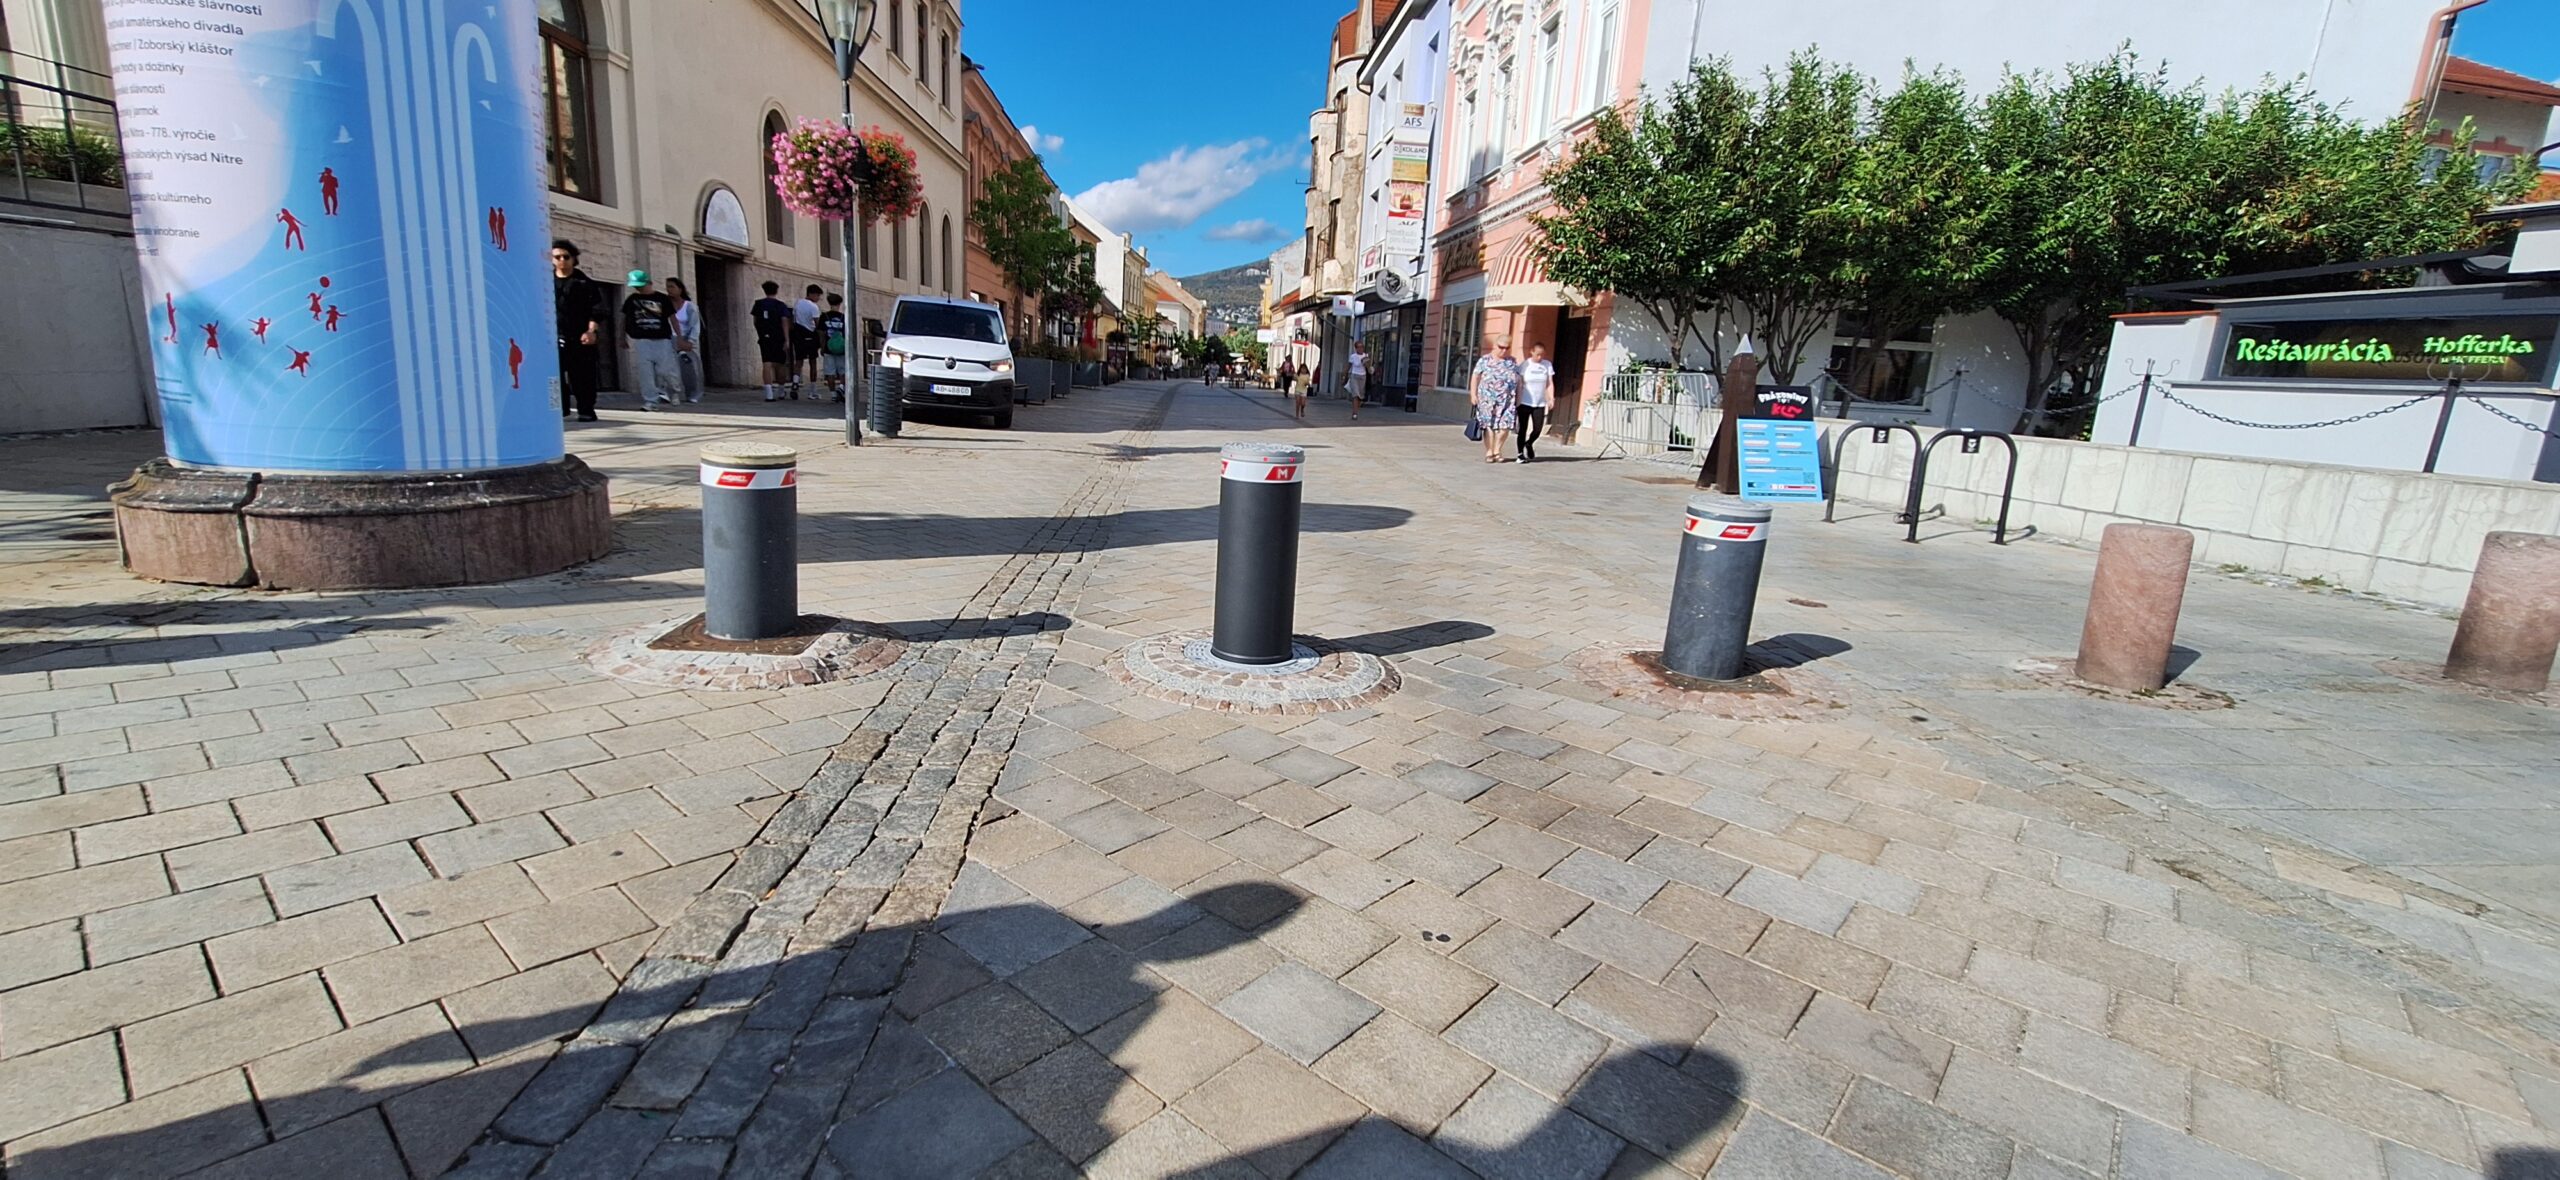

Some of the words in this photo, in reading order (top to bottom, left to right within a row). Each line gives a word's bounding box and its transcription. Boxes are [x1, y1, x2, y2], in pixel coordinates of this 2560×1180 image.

[193, 21, 243, 36] divadla
[138, 39, 184, 54] Zoborský
[189, 42, 233, 57] kláštor
[146, 62, 184, 75] dožinky
[1404, 117, 1423, 127] AFS
[173, 129, 216, 141] výročie
[175, 150, 207, 164] výsad
[211, 152, 244, 165] Nitre
[157, 192, 212, 205] kultúrneho
[2238, 337, 2393, 364] Reštaurácia
[2424, 334, 2534, 353] Hofferka
[1277, 468, 1289, 479] M
